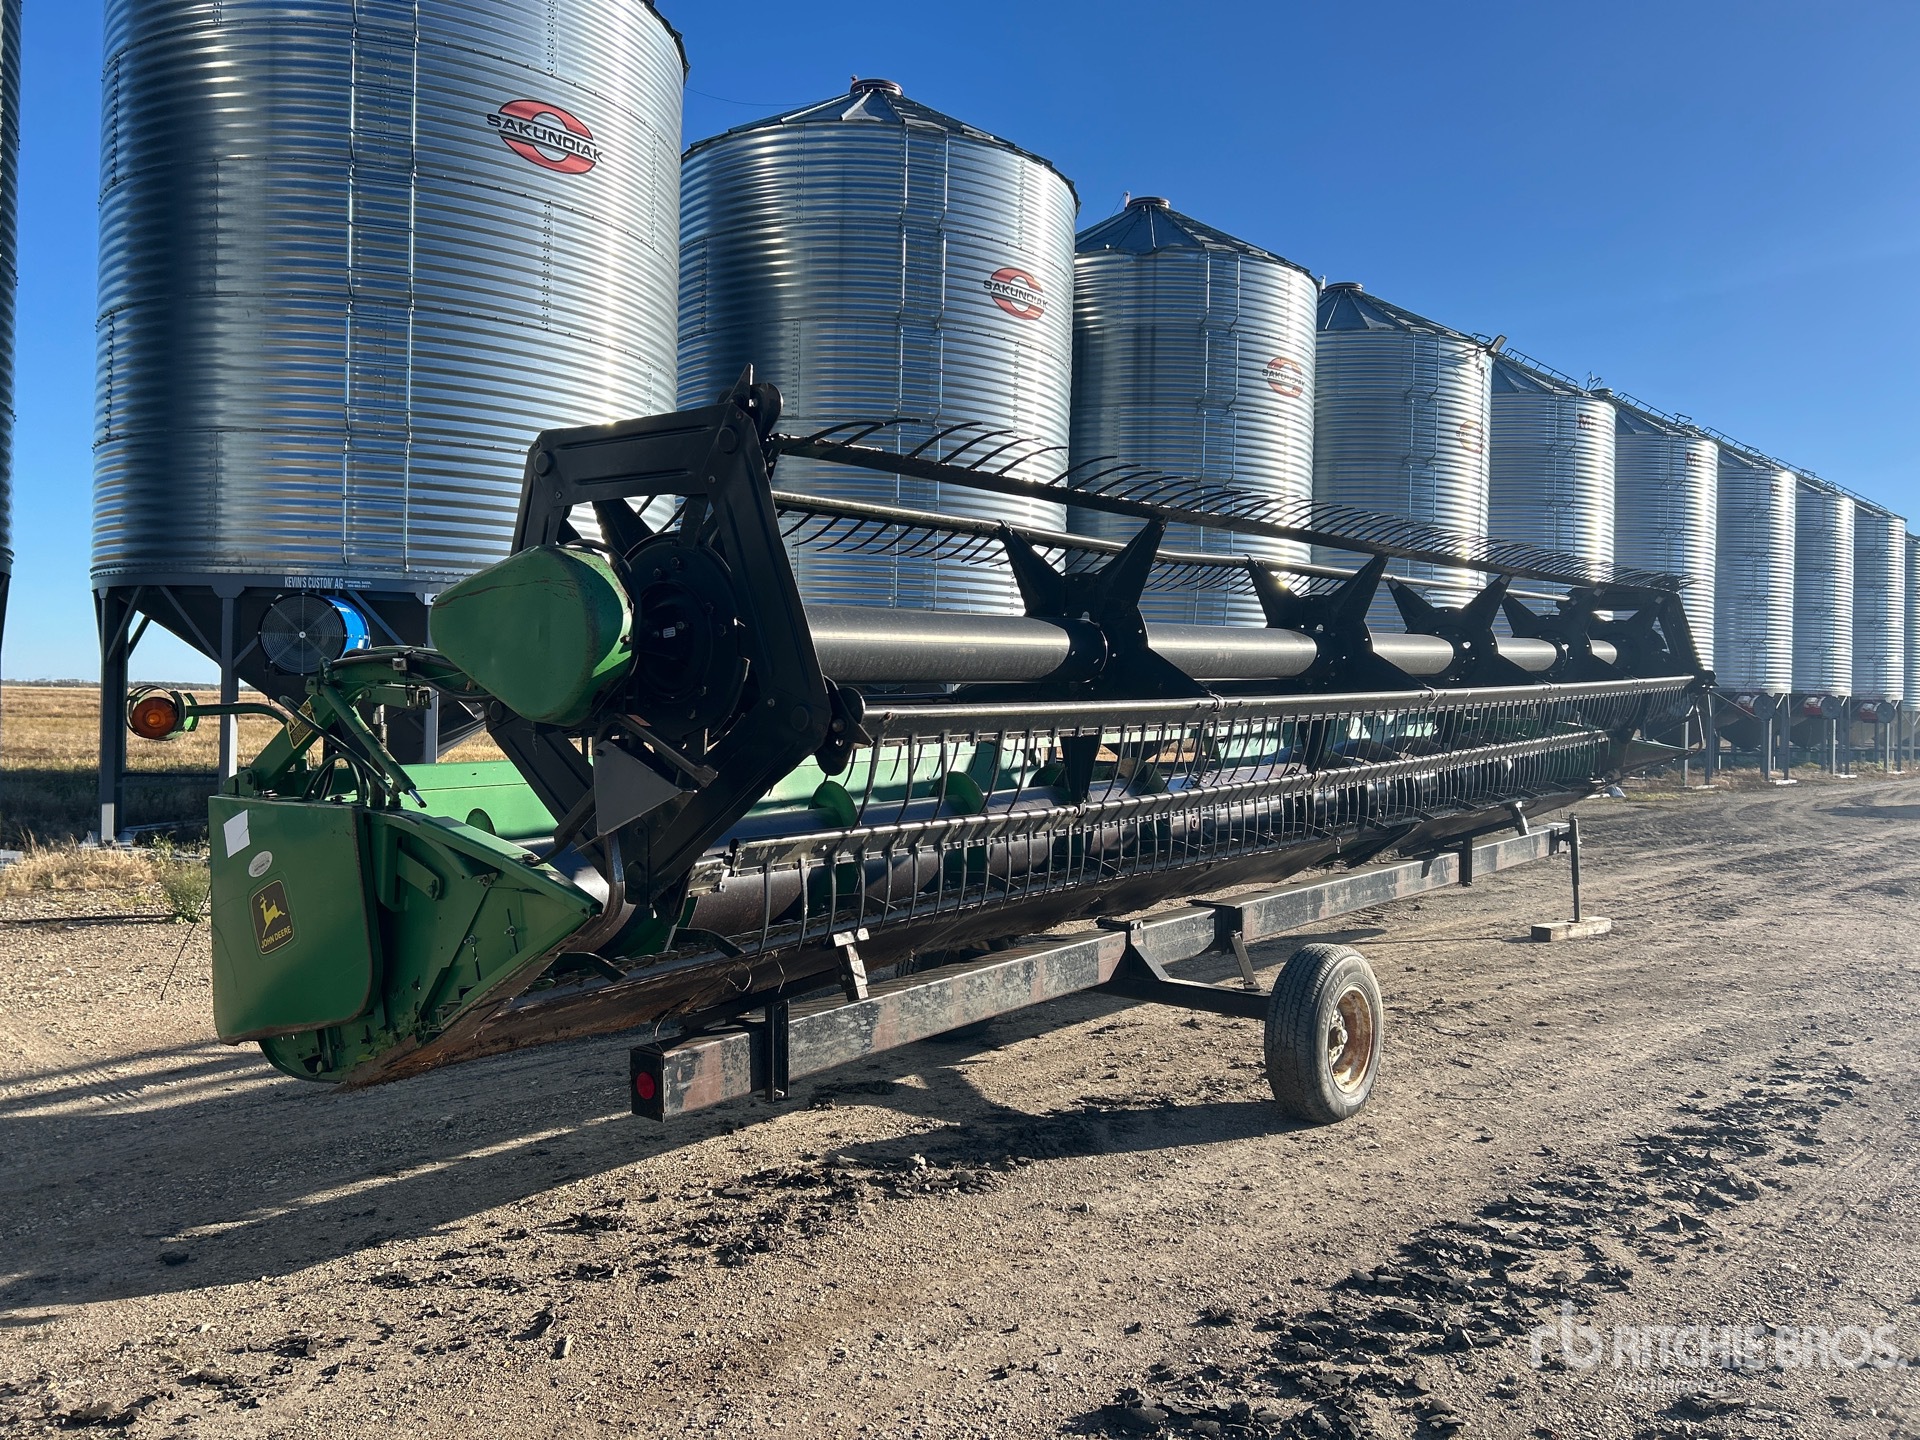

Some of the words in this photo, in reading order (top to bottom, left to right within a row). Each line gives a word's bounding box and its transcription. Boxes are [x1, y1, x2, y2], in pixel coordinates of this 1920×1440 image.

[487, 113, 604, 163] SAKUNDIAK
[983, 280, 1048, 308] SAKUNDIAK
[334, 578, 344, 590] AG
[261, 936, 275, 949] JOHN
[274, 925, 292, 941] DEERE
